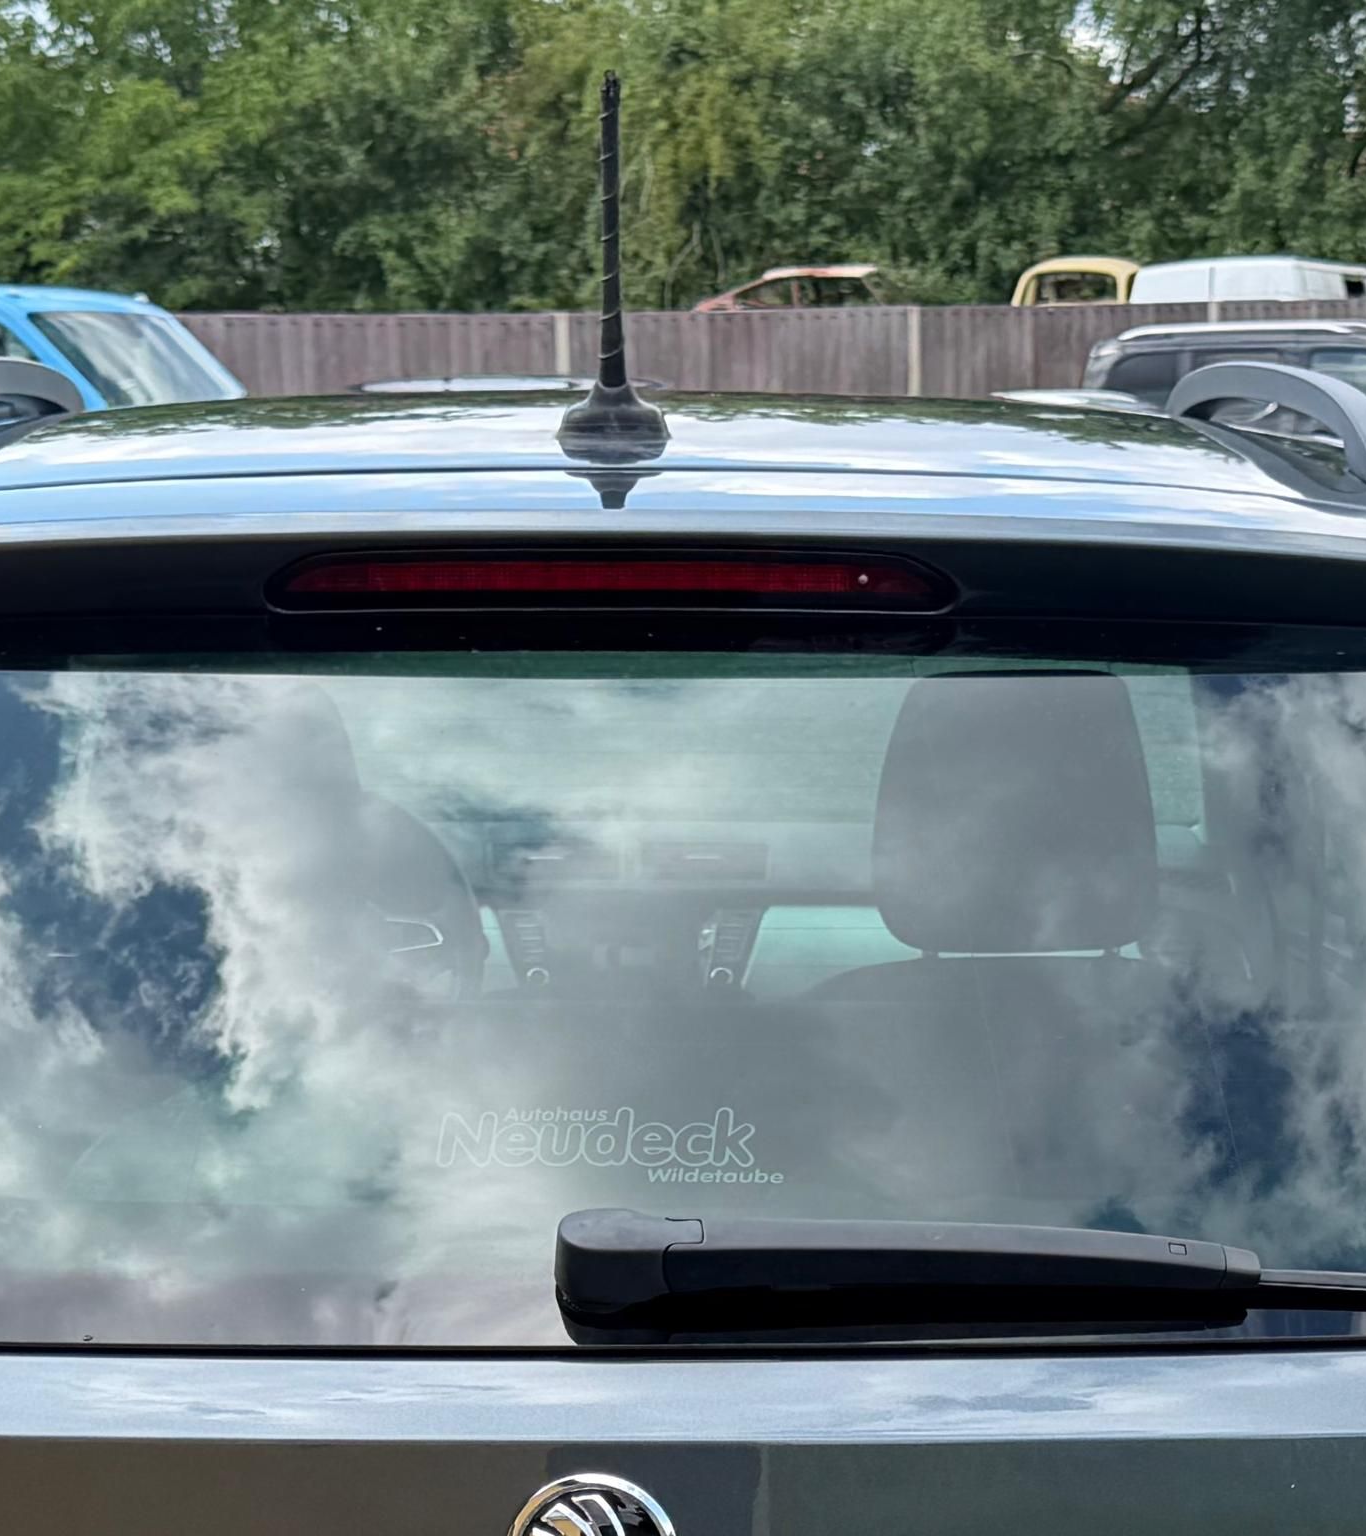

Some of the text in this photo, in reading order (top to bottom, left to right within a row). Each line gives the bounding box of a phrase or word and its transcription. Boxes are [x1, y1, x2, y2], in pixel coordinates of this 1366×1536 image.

[503, 1106, 609, 1122] Autohaus
[436, 1106, 755, 1168] Neudeck
[647, 1167, 784, 1184] Wildetaube
